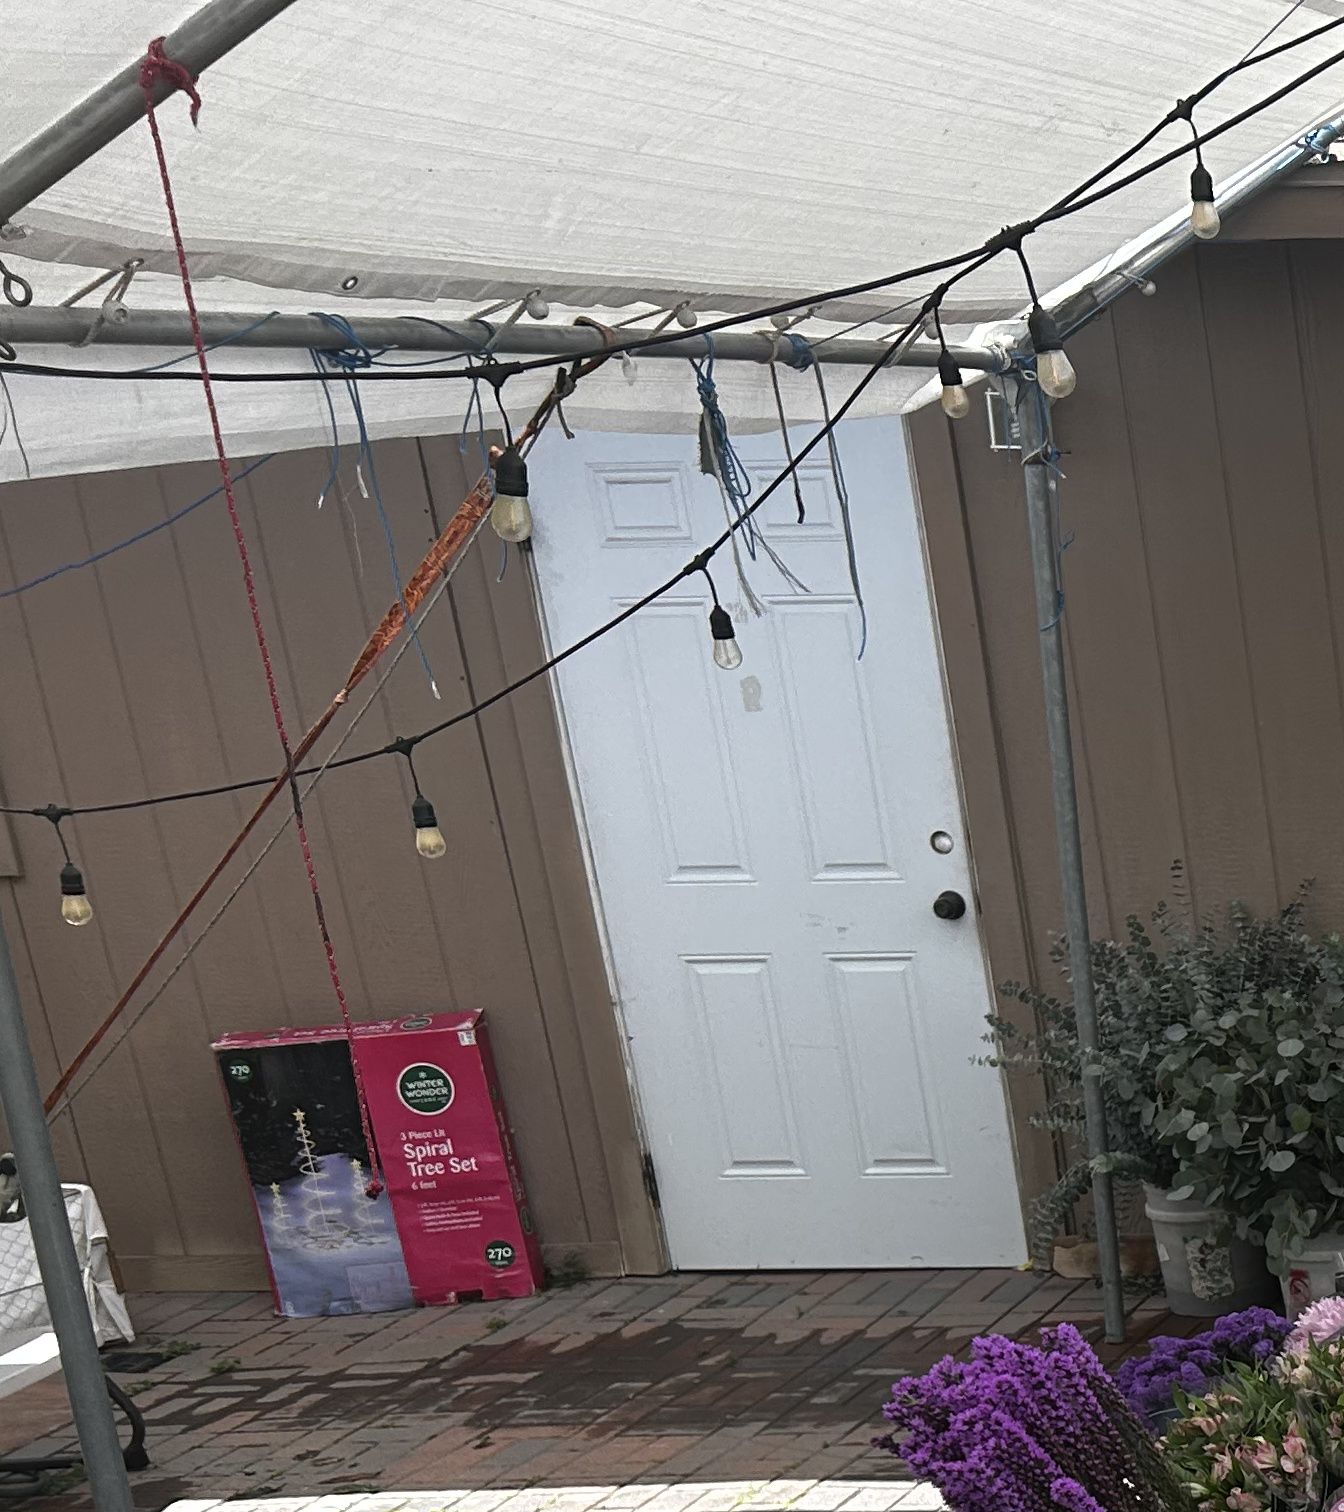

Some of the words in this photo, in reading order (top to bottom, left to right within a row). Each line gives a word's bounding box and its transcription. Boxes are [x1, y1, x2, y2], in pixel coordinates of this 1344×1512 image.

[230, 1065, 250, 1076] 270
[405, 1079, 444, 1090] WINTER
[405, 1087, 449, 1098] WONDER
[400, 1131, 407, 1141] 3
[403, 1138, 454, 1162] Spiral
[406, 1161, 446, 1178] Tree
[449, 1156, 479, 1174] Set
[487, 1246, 513, 1261] 270
